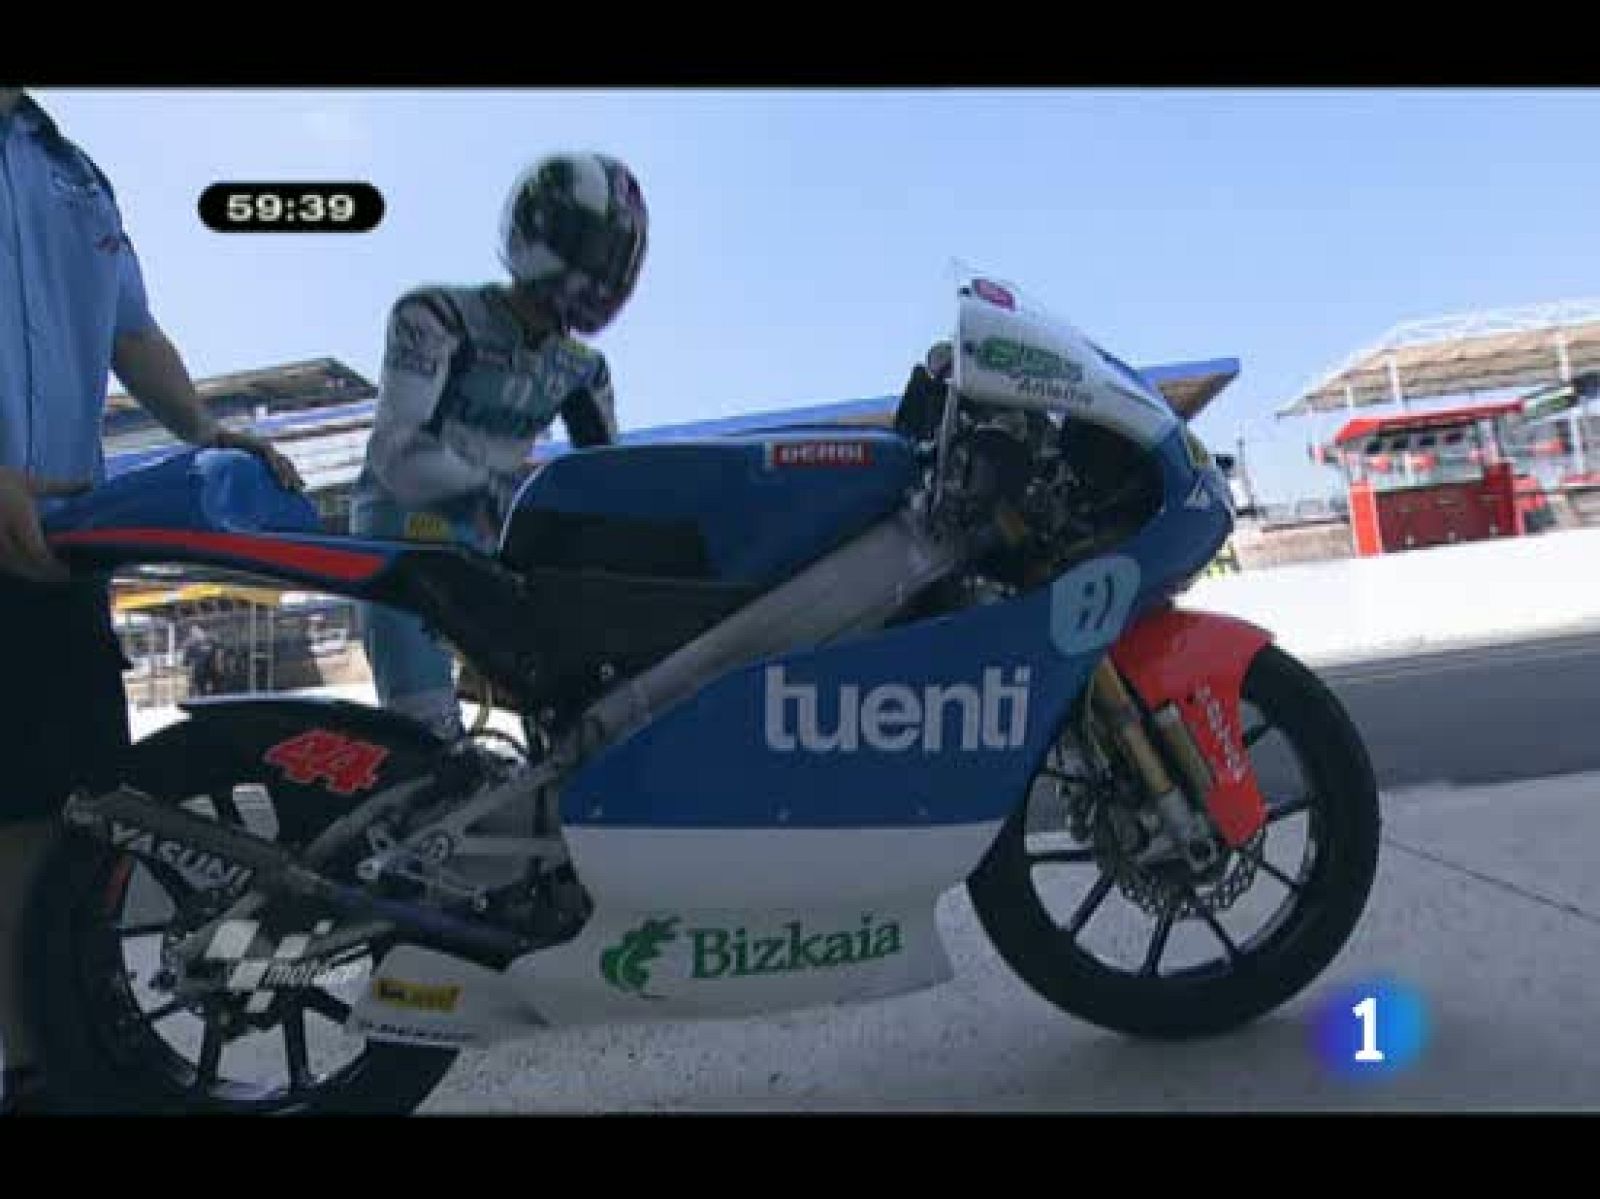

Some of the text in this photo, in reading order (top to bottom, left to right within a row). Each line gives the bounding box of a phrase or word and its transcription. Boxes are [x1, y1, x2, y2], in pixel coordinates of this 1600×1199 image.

[765, 664, 1031, 752] tuenti
[263, 729, 389, 793] 44
[110, 821, 252, 896] YASUNI
[687, 911, 901, 979] Bizkaia
